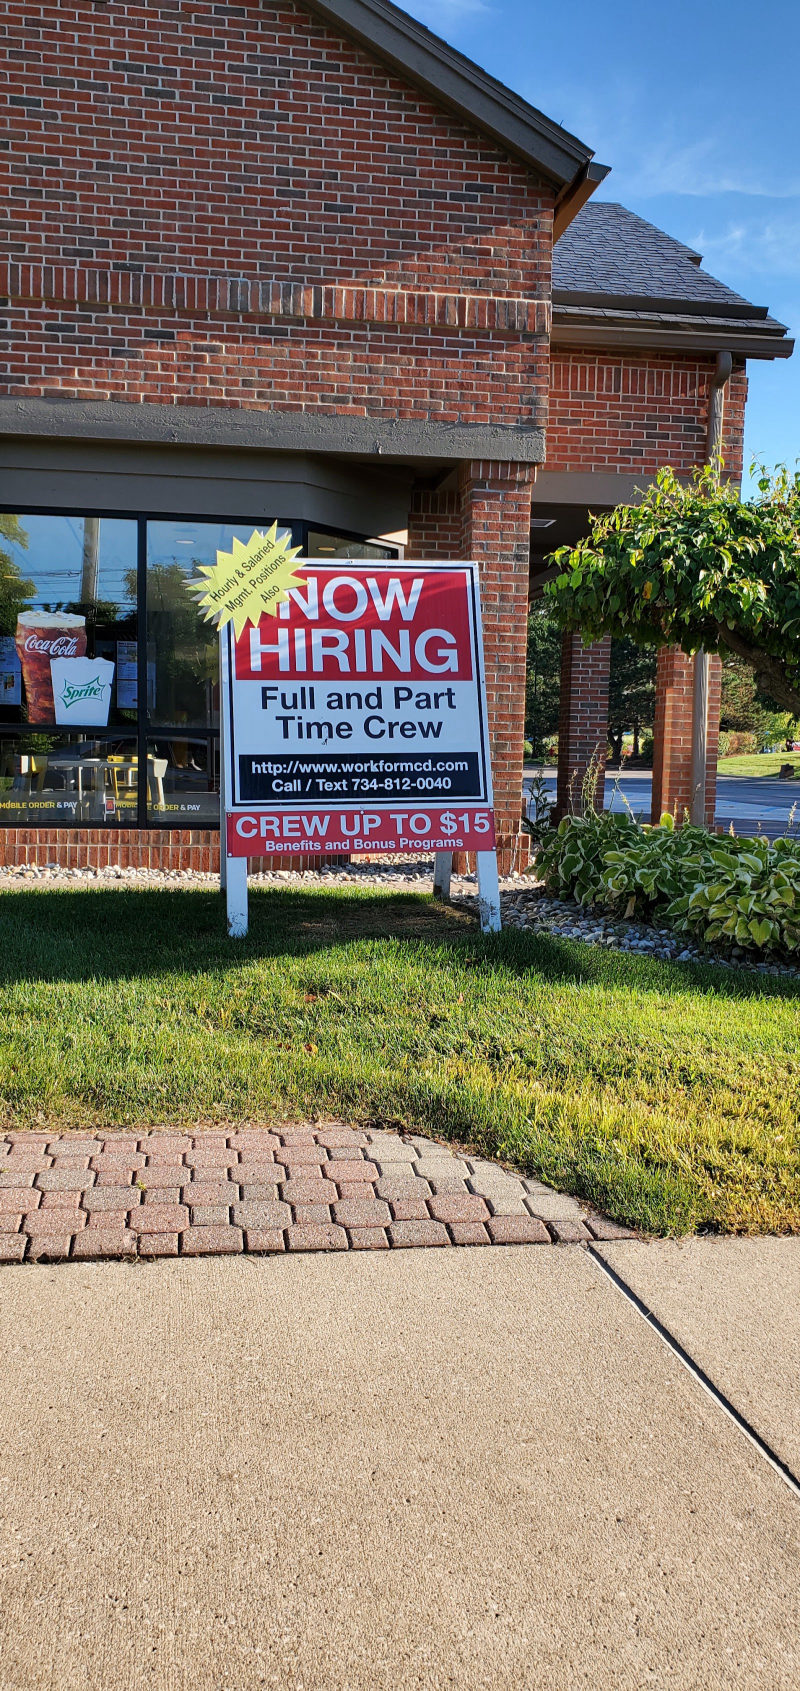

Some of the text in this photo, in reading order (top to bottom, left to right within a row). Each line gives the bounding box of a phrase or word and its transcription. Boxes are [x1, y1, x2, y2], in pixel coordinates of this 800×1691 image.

[209, 539, 275, 602] Hourly & Salaried
[224, 554, 286, 612] Mgmt. Positions
[260, 585, 280, 604] Also
[279, 576, 424, 622] NOW
[249, 627, 459, 674] HIRING
[63, 685, 101, 700] Sprite
[261, 686, 457, 710] Full and Part
[275, 715, 443, 739] Time Crew
[251, 760, 469, 776] http://www.workformcd.com
[271, 776, 452, 792] Call / Text 734-812-0040
[0, 801, 78, 810] MOBILE ORDER & PAY
[235, 810, 490, 838] CREW UP TO $15
[265, 836, 464, 852] Benefits and Bonus Programs
